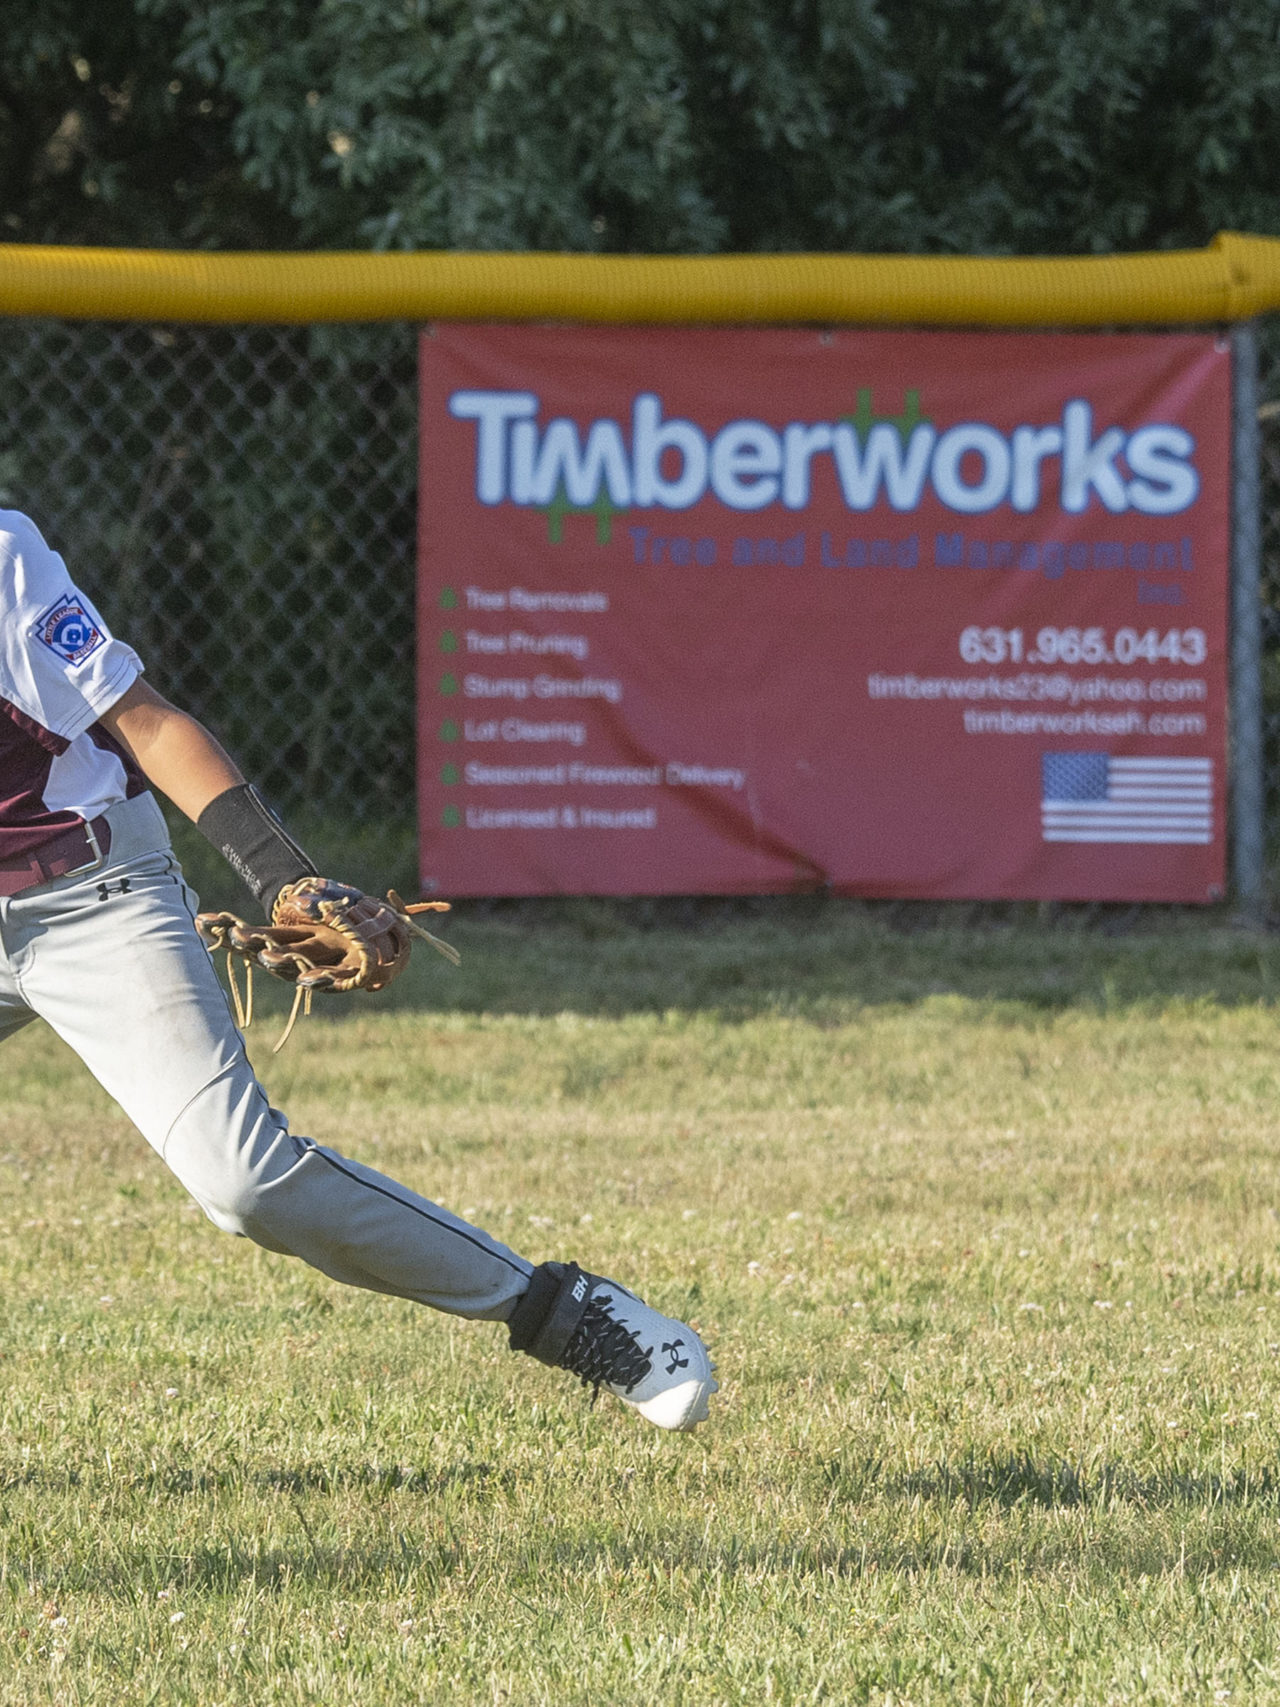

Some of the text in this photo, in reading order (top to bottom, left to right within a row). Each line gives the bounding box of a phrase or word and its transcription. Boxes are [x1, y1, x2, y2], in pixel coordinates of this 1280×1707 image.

[451, 391, 1198, 514] Timberworks
[628, 526, 1194, 580] Tree and Land Management
[466, 586, 608, 612] Tree Removals
[466, 630, 588, 660] Tree Pruning
[959, 626, 1207, 665] 631.965.0443
[465, 674, 622, 703] Stump Grinding
[465, 720, 498, 741] Lot
[572, 1275, 588, 1302] BH
